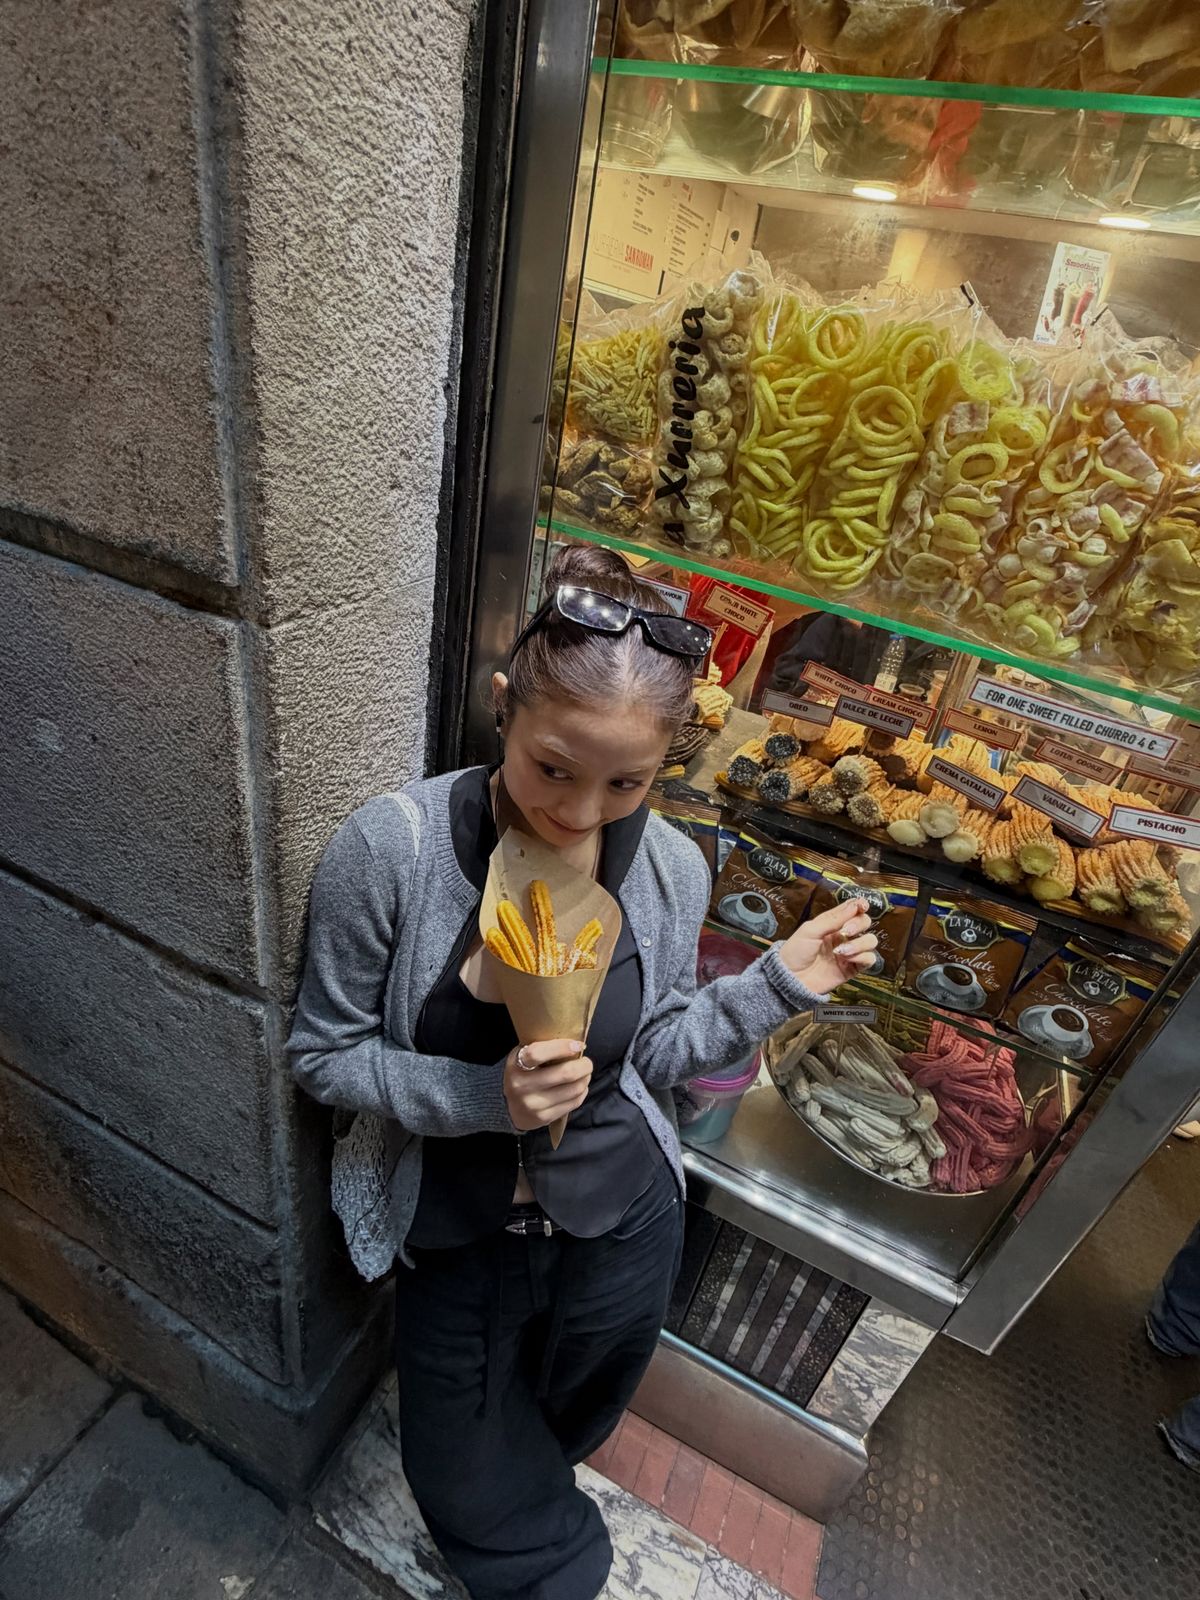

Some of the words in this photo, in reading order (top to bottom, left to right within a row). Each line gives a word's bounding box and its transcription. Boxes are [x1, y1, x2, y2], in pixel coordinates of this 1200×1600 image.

[724, 608, 745, 622] CHOCO
[739, 603, 758, 619] WHITE
[814, 670, 834, 684] WHITE
[835, 680, 857, 694] CHOCO
[842, 702, 866, 716] DULCE
[867, 710, 879, 719] DE
[879, 714, 904, 728] LECHE
[872, 696, 897, 710] CREAM
[897, 704, 923, 718] CHOCO
[973, 723, 998, 736] LEMON
[985, 689, 1006, 704] FOR
[1006, 696, 1027, 711] ONE
[1027, 703, 1060, 721] SWEET
[1060, 713, 1094, 732] FILLED
[1095, 724, 1137, 745] CHURRO
[1137, 737, 1146, 748] 4
[1148, 740, 1157, 750] €
[1050, 748, 1073, 761] LOTUS
[1076, 758, 1104, 773] COOKIE
[935, 762, 959, 780] CREMA
[960, 776, 996, 800] CATALANA
[1042, 794, 1077, 817] VAINILLA
[1137, 818, 1187, 835] PISTACHO
[764, 857, 789, 878] PLATA
[949, 916, 961, 928] LA
[964, 918, 993, 938] PLATA
[929, 944, 996, 973] Chocolate
[1075, 965, 1089, 975] LA
[1092, 971, 1120, 995] PLATA
[1044, 983, 1112, 1026] Chocolate
